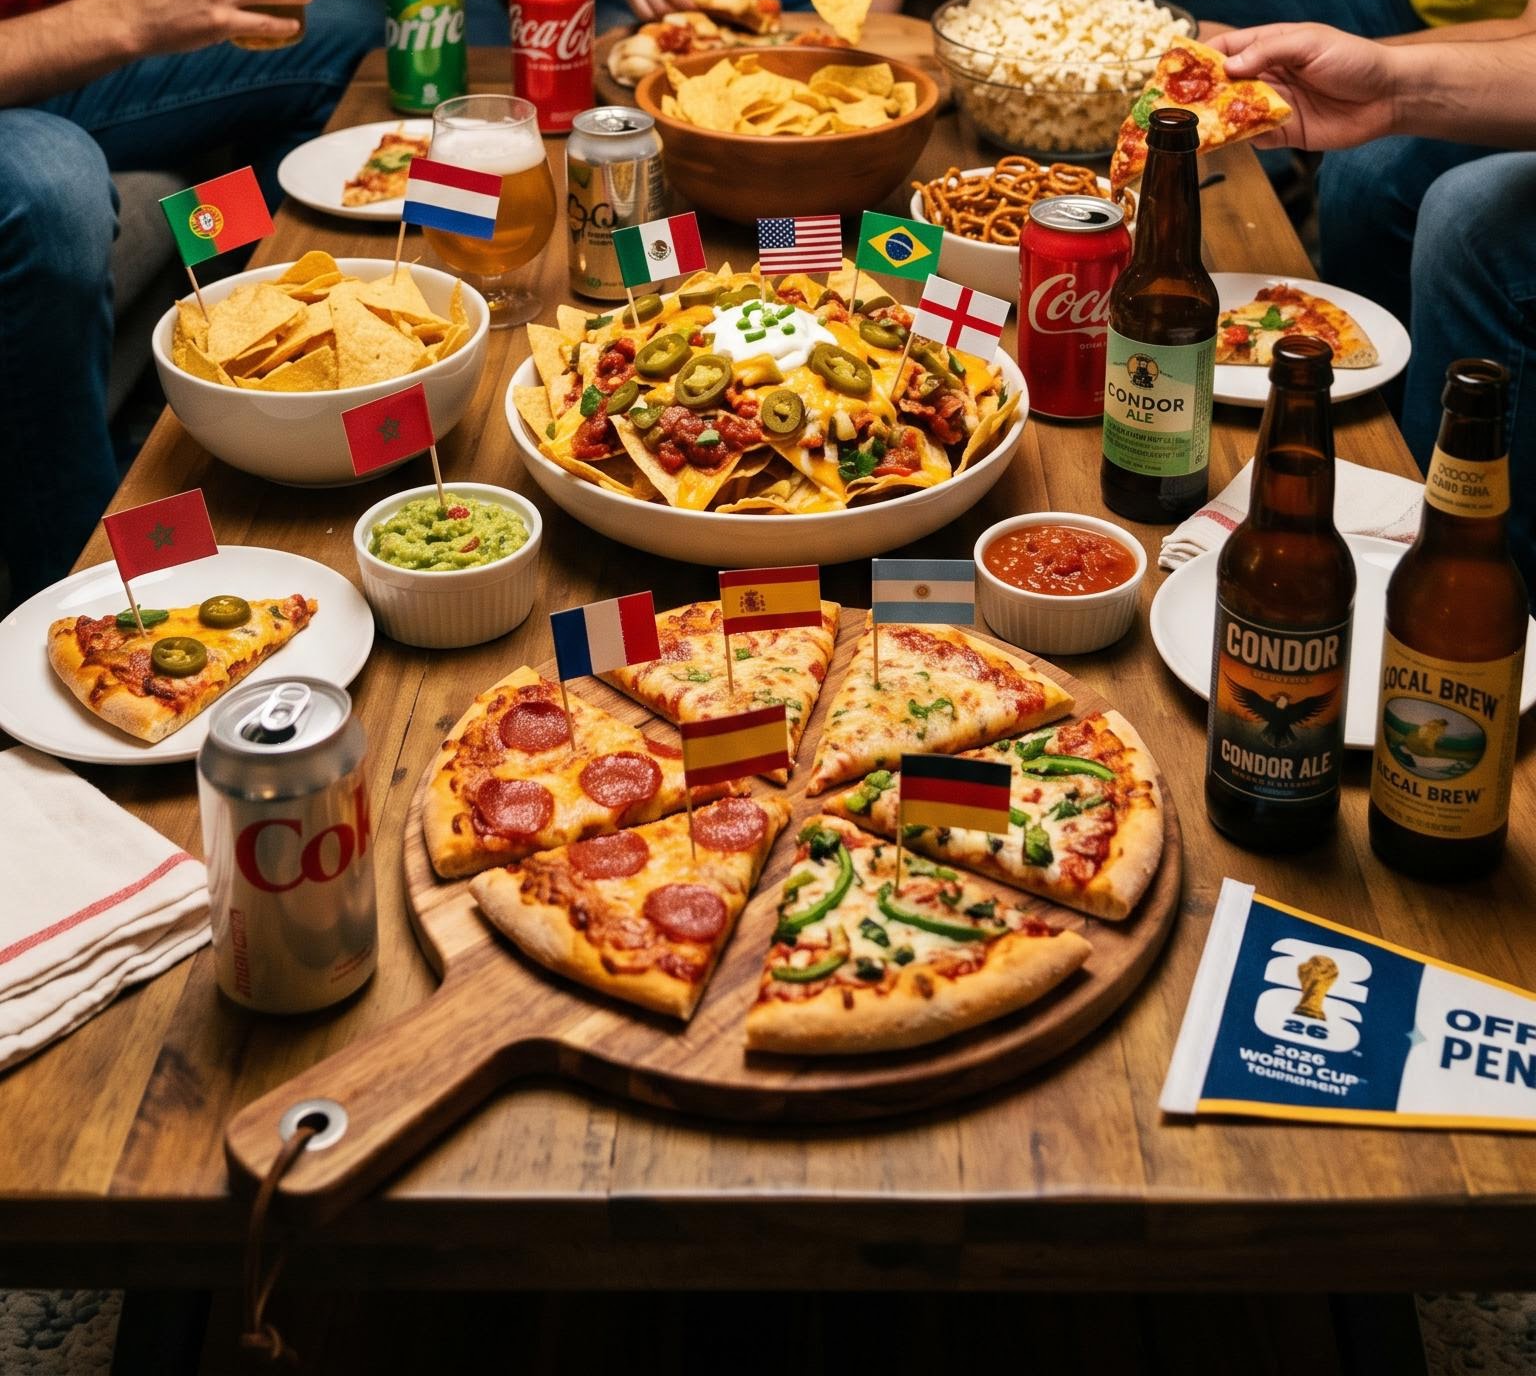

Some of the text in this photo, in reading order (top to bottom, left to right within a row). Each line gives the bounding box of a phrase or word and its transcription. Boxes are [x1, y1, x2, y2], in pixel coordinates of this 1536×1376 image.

[1108, 382, 1185, 412] CONDOR
[1126, 409, 1155, 424] ALE
[1226, 622, 1340, 672] CONDOR
[1439, 677, 1498, 722] BREW
[1221, 738, 1294, 780] CONDOR
[1299, 751, 1332, 780] ALE
[1427, 786, 1481, 805] BREW
[1282, 1019, 1329, 1040] 26
[1239, 1047, 1360, 1086] WORLD CUP
[1272, 1044, 1327, 1066] 2026
